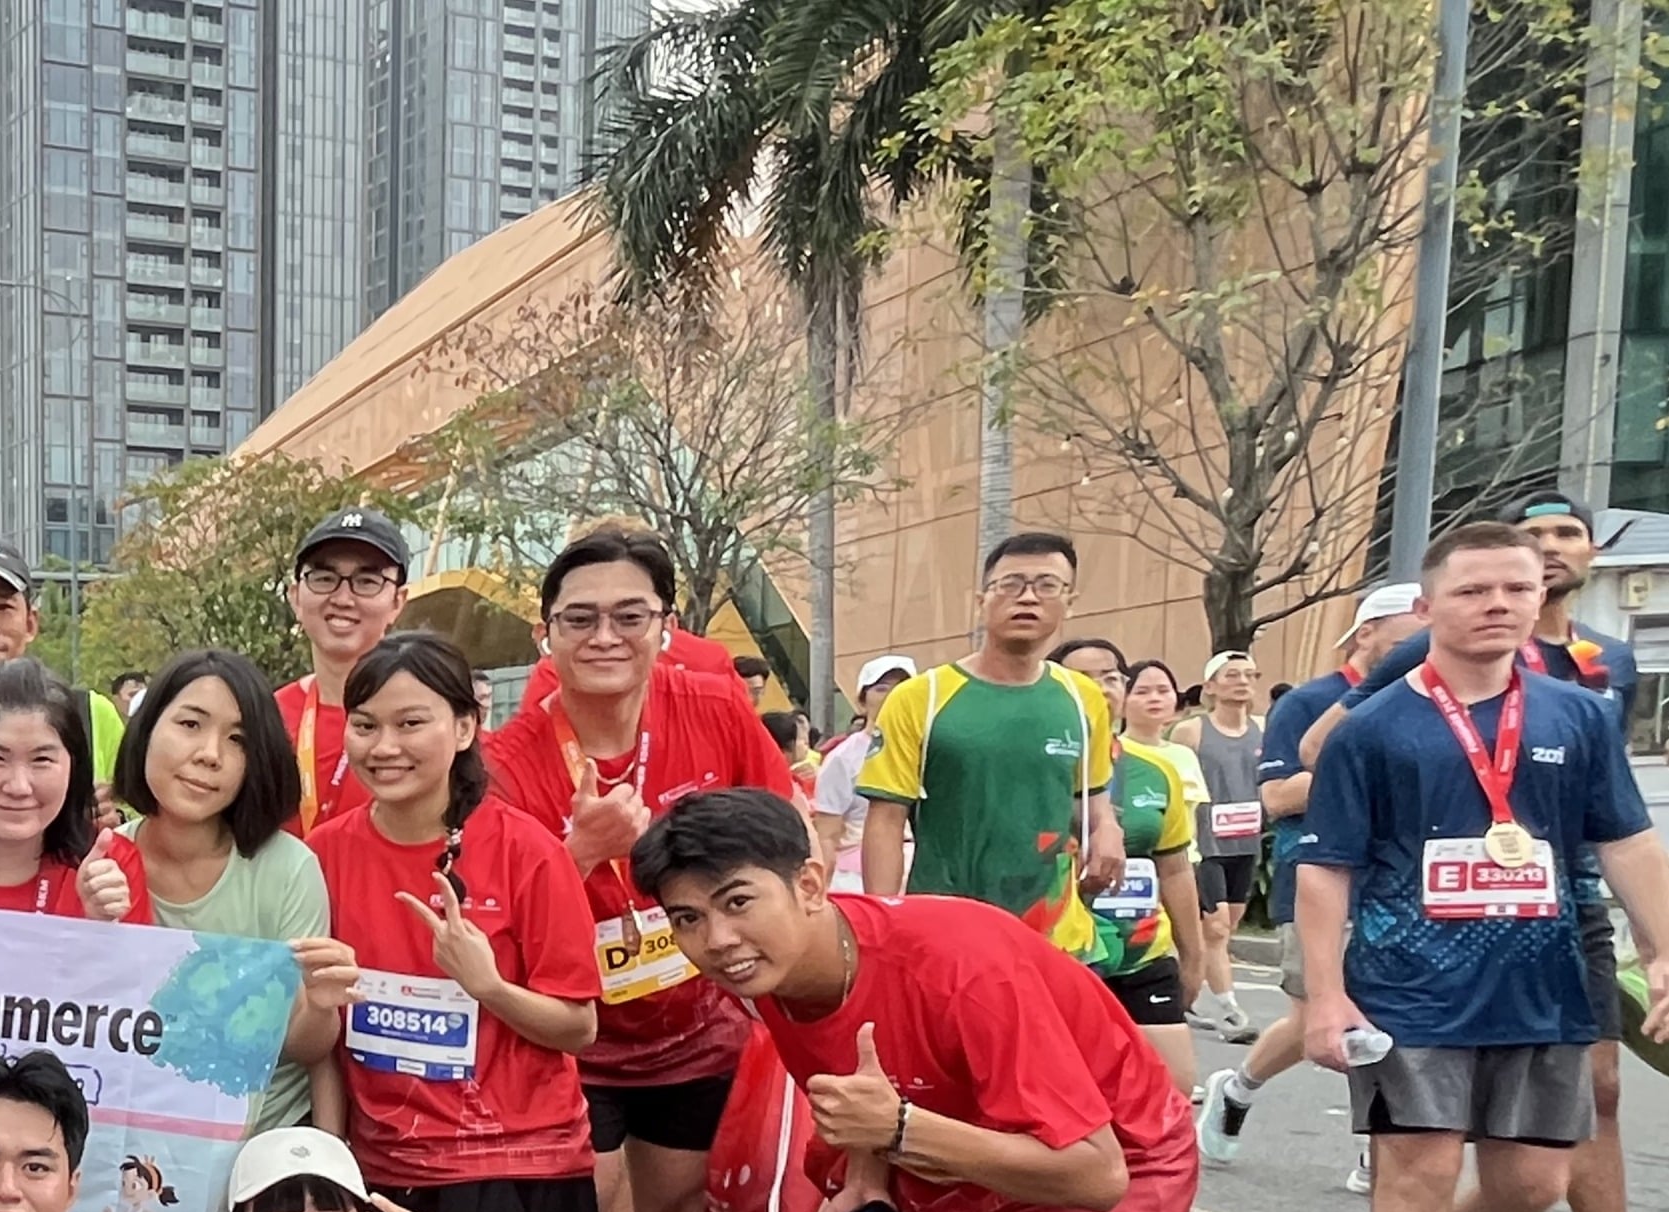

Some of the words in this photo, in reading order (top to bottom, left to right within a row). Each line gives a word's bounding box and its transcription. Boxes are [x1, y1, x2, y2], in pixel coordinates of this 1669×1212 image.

[1437, 865, 1461, 889] E
[605, 946, 630, 970] D
[366, 1004, 449, 1036] 308514
